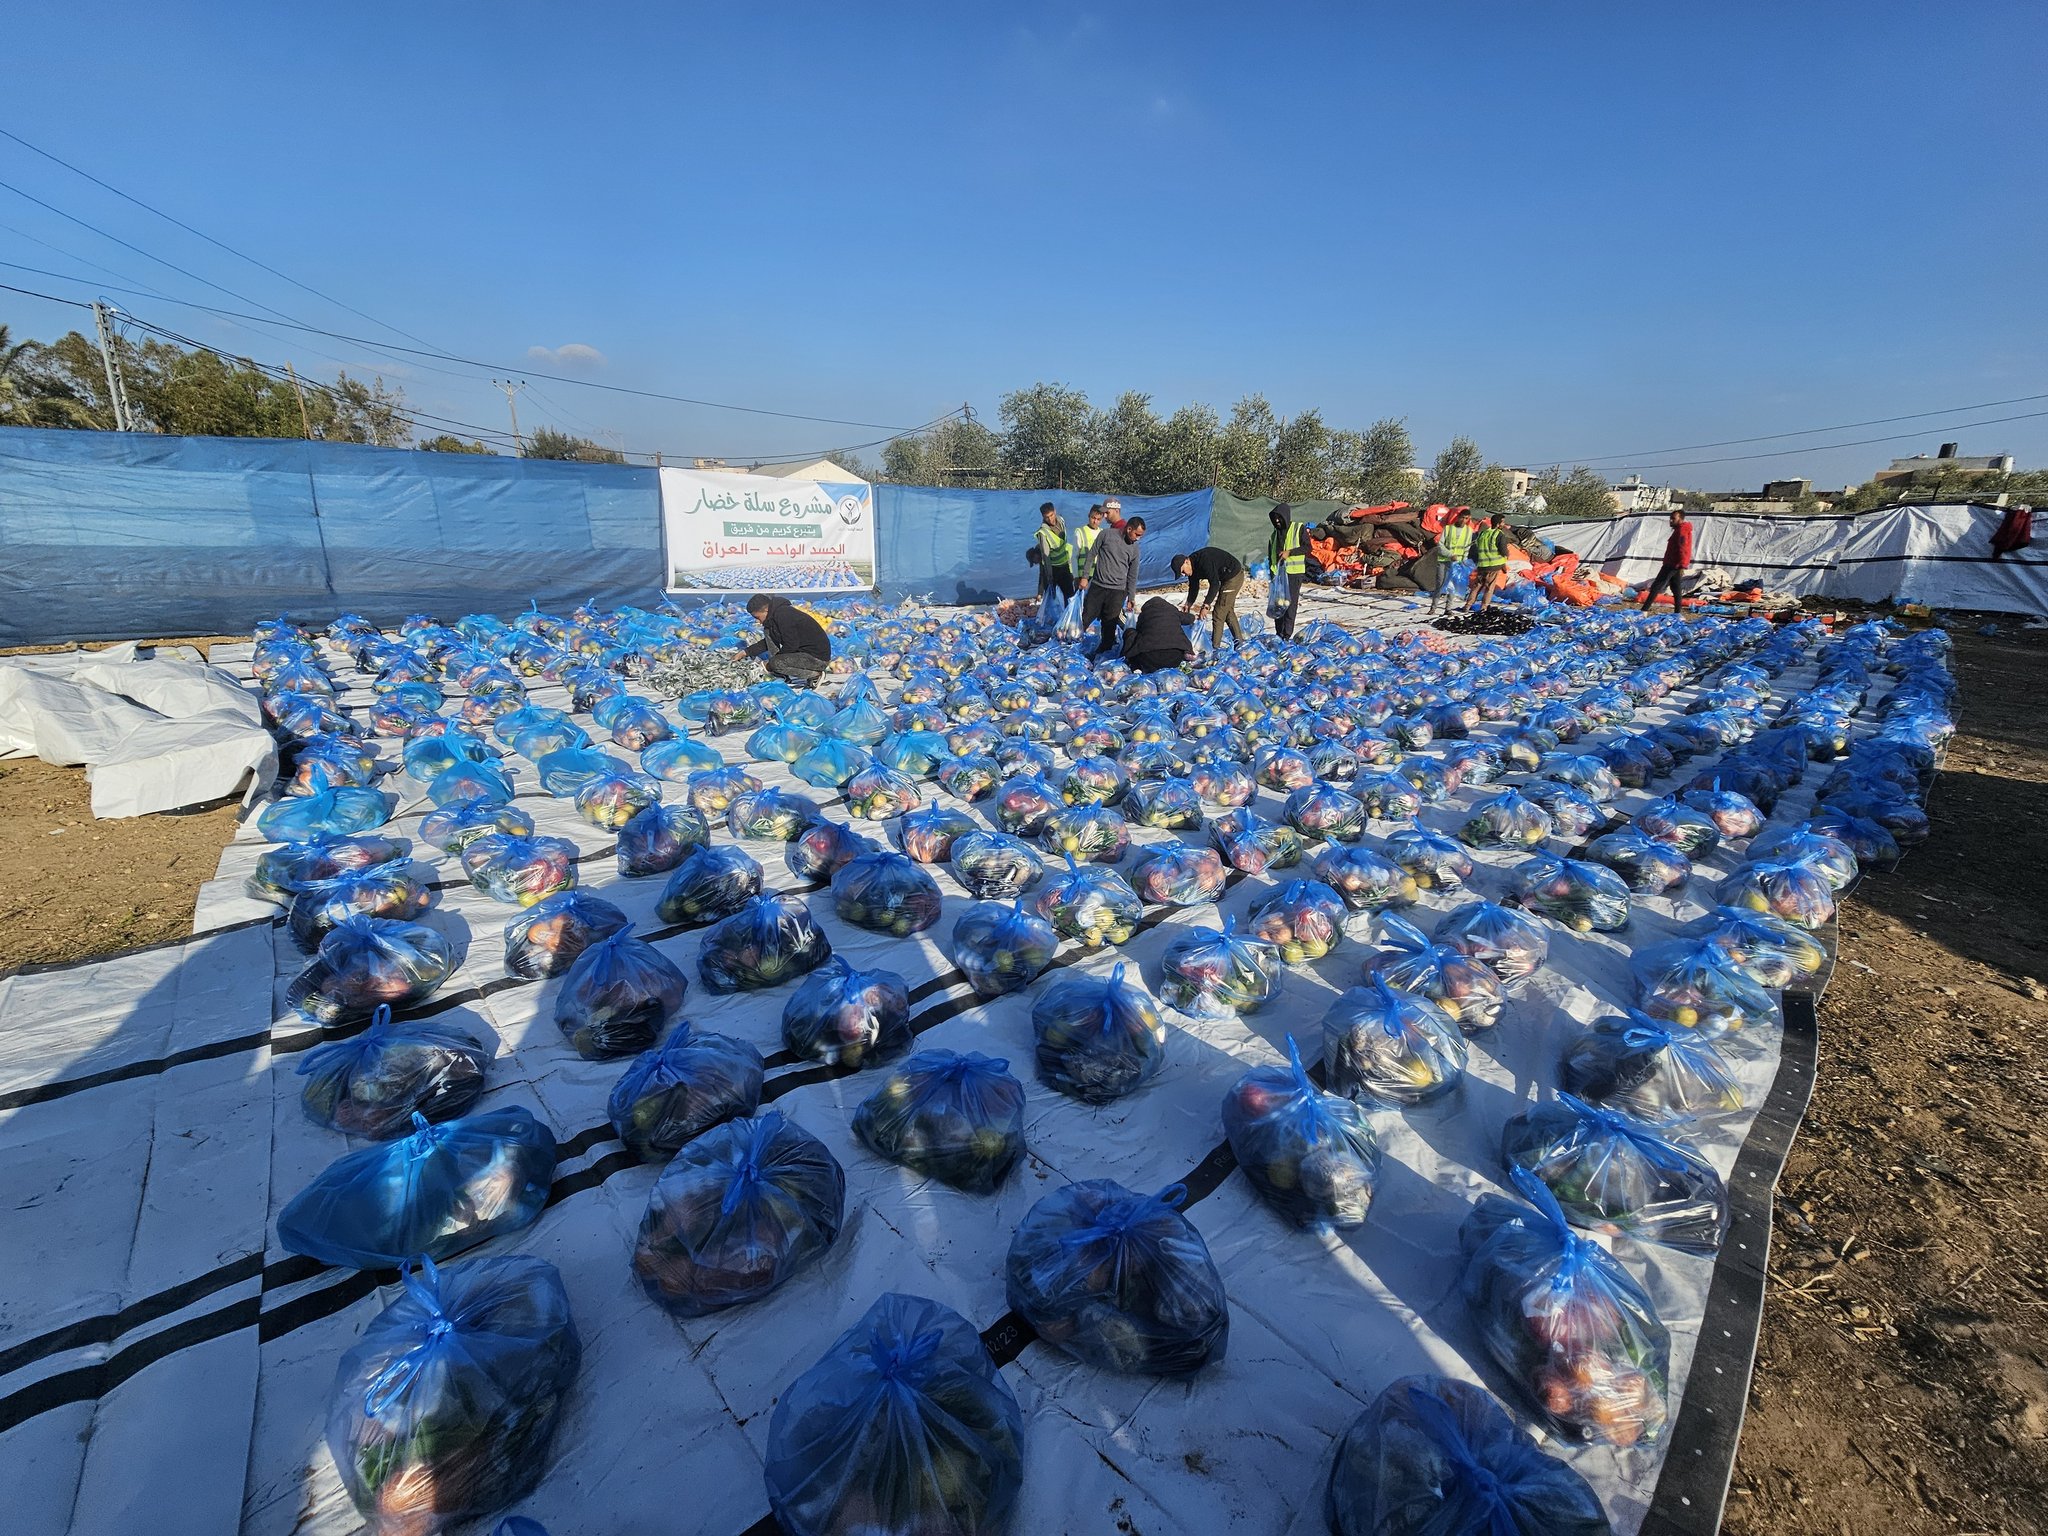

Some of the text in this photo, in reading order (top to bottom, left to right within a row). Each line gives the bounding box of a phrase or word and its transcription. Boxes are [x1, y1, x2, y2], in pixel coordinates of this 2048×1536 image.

[684, 487, 832, 519] مشروع سلة خضار
[730, 523, 816, 538] بتبرع كريم من فريق
[766, 543, 805, 559] الواحد
[810, 543, 845, 559] الجسد
